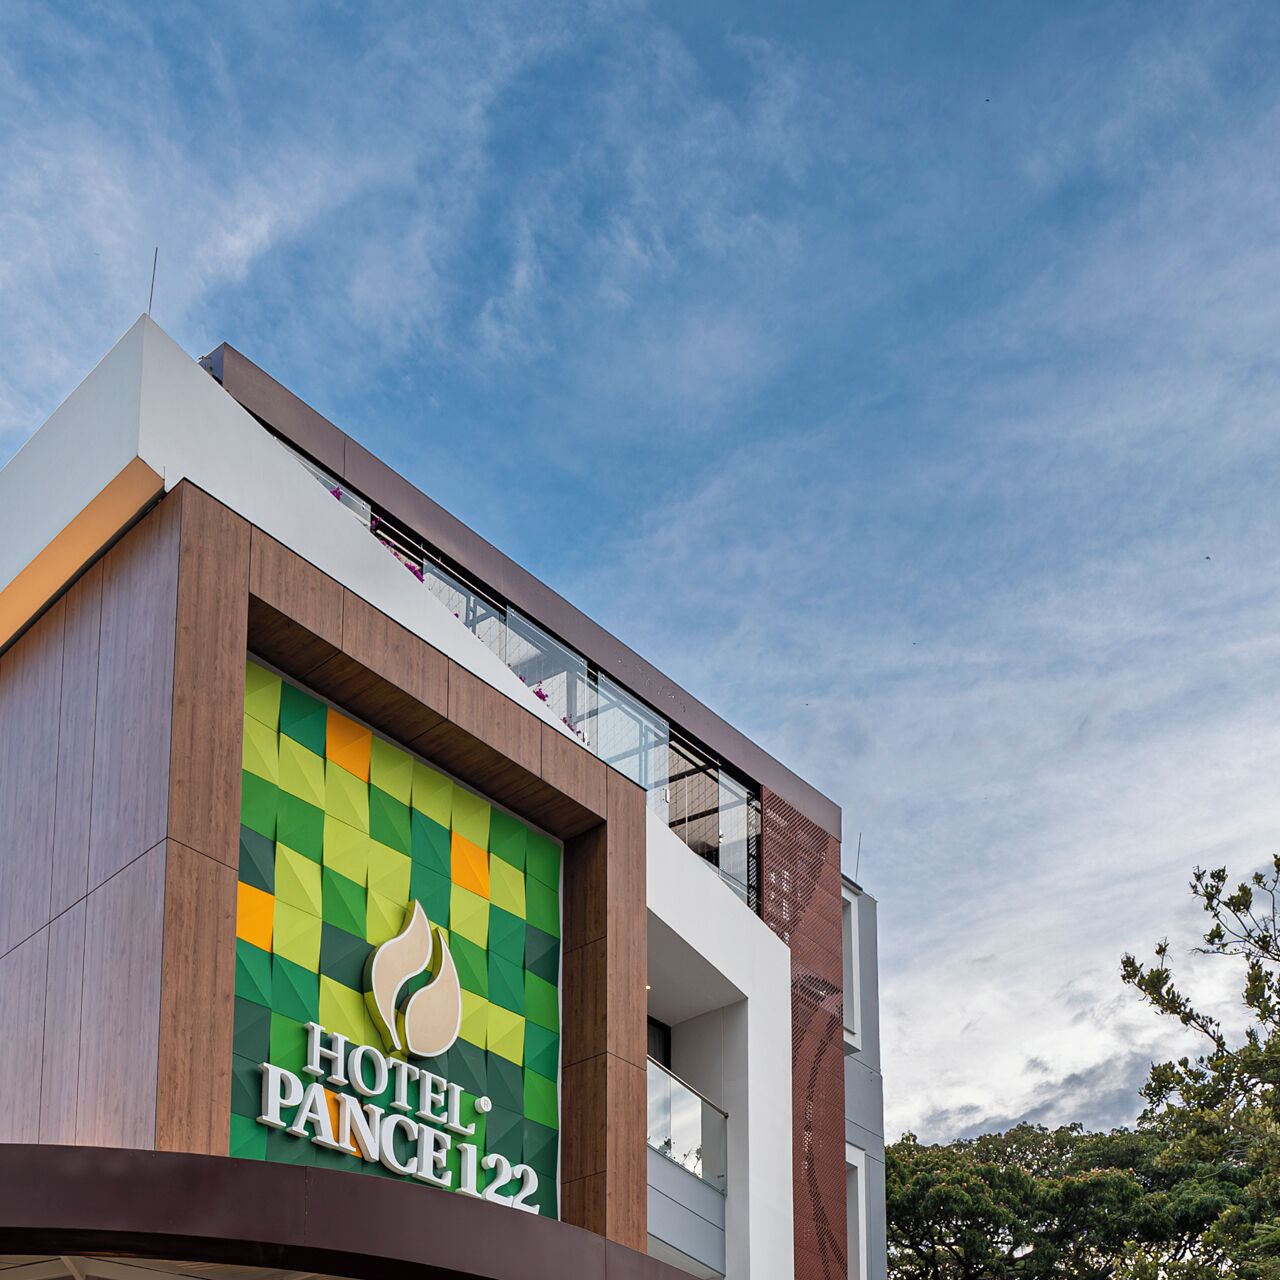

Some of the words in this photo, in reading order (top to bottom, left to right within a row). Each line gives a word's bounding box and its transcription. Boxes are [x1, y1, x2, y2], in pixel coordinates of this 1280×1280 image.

[256, 1062, 452, 1188] PANCE
[455, 1142, 540, 1215] 122
[303, 1021, 476, 1136] HOTEL
